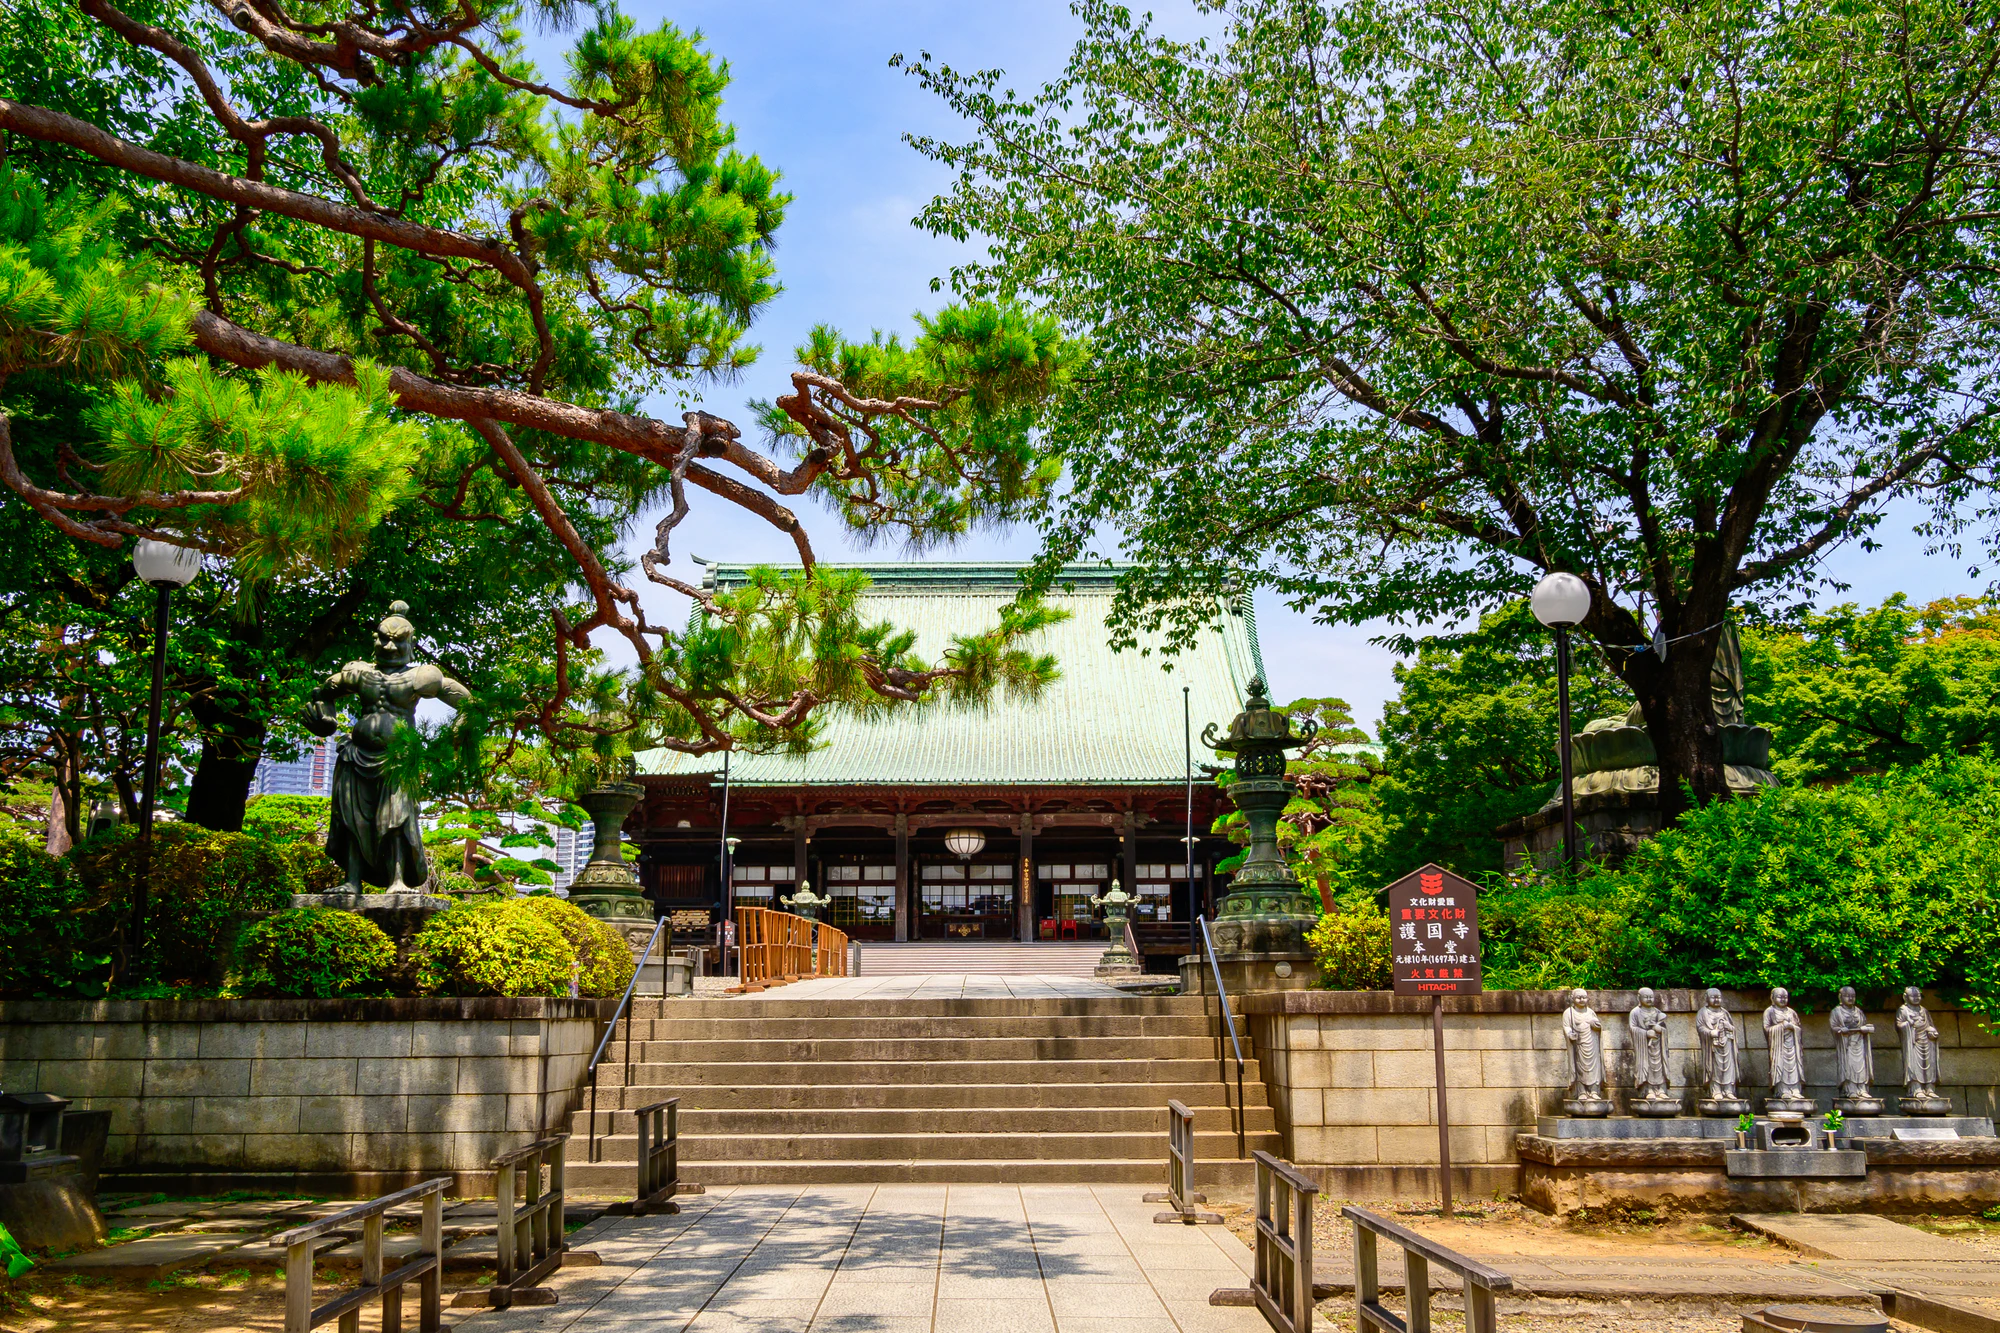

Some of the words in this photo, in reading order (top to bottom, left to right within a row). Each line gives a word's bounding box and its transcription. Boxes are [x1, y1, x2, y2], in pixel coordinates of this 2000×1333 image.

[1401, 908, 1466, 920] 重要文化財
[1399, 921, 1469, 939] 護国寺
[1411, 968, 1464, 979] 火気厳禁
[1418, 983, 1457, 991] HITACHI
